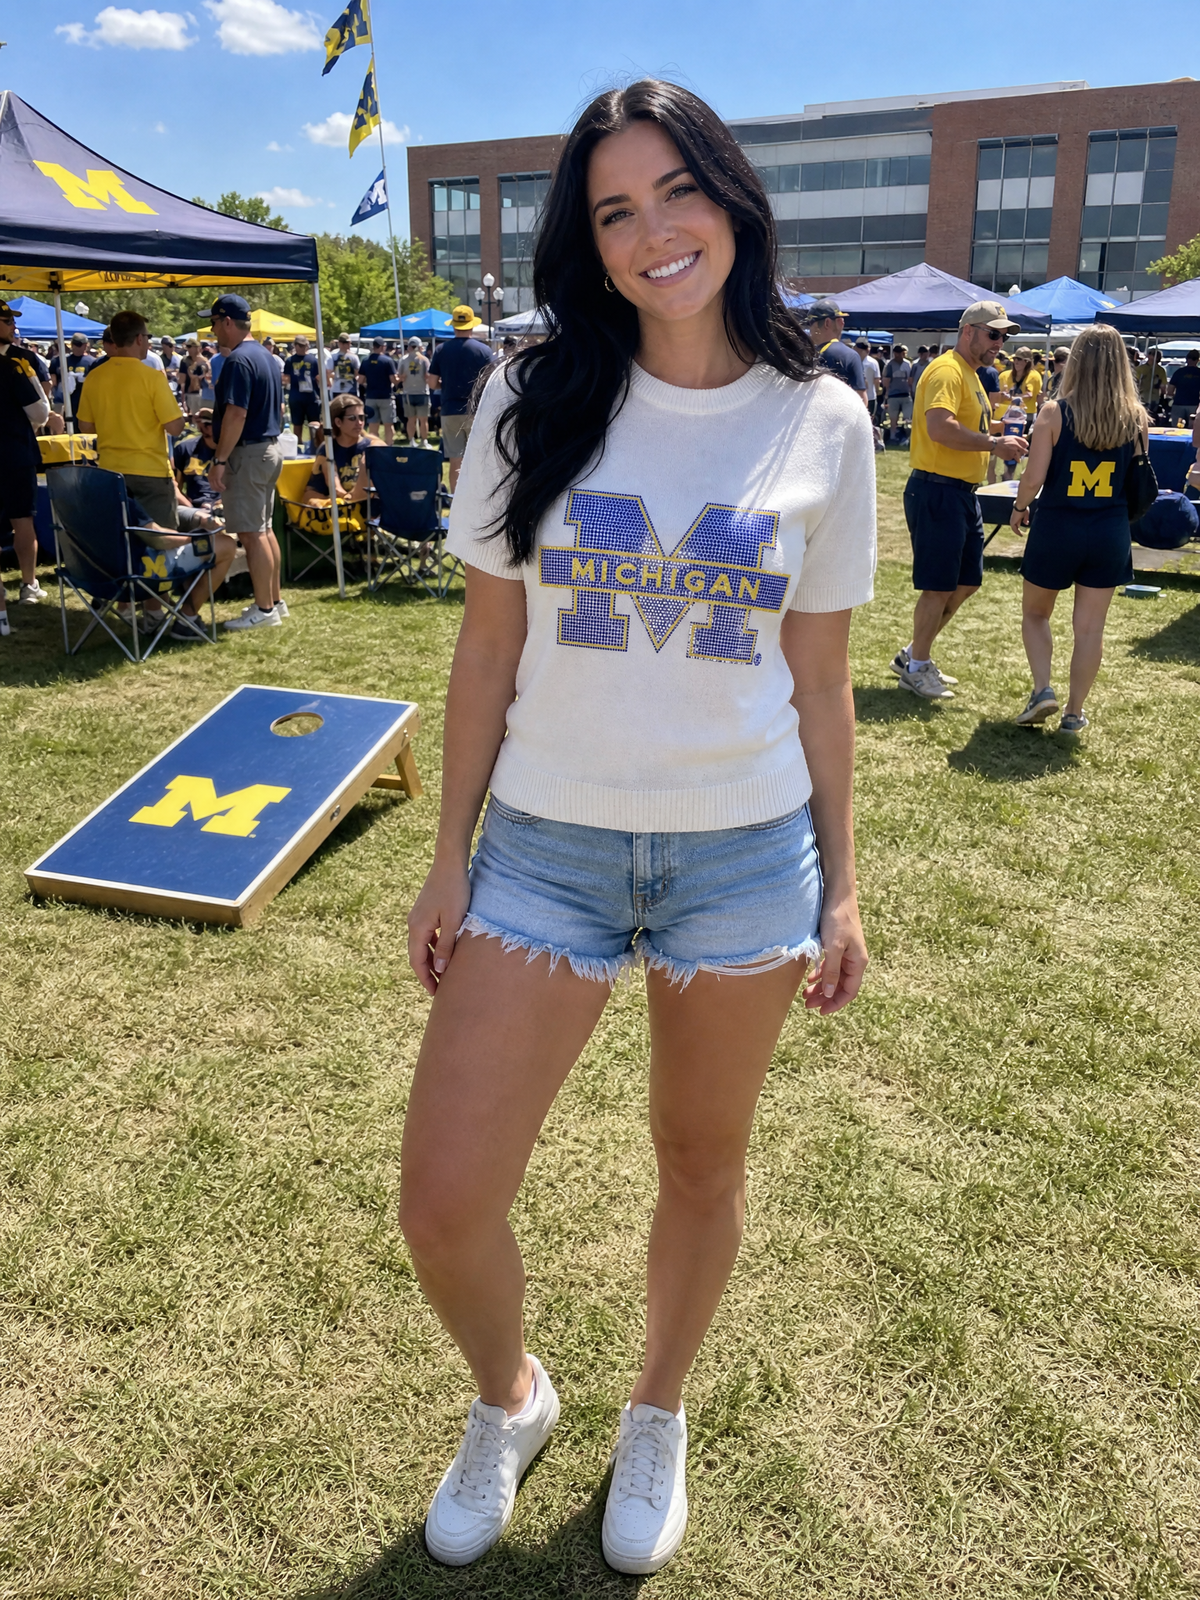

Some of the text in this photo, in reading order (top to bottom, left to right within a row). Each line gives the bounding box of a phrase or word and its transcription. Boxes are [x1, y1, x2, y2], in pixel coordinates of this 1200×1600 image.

[33, 160, 159, 216] M
[1067, 461, 1115, 498] M
[571, 557, 761, 601] MICHIGAN
[128, 775, 292, 837] M
